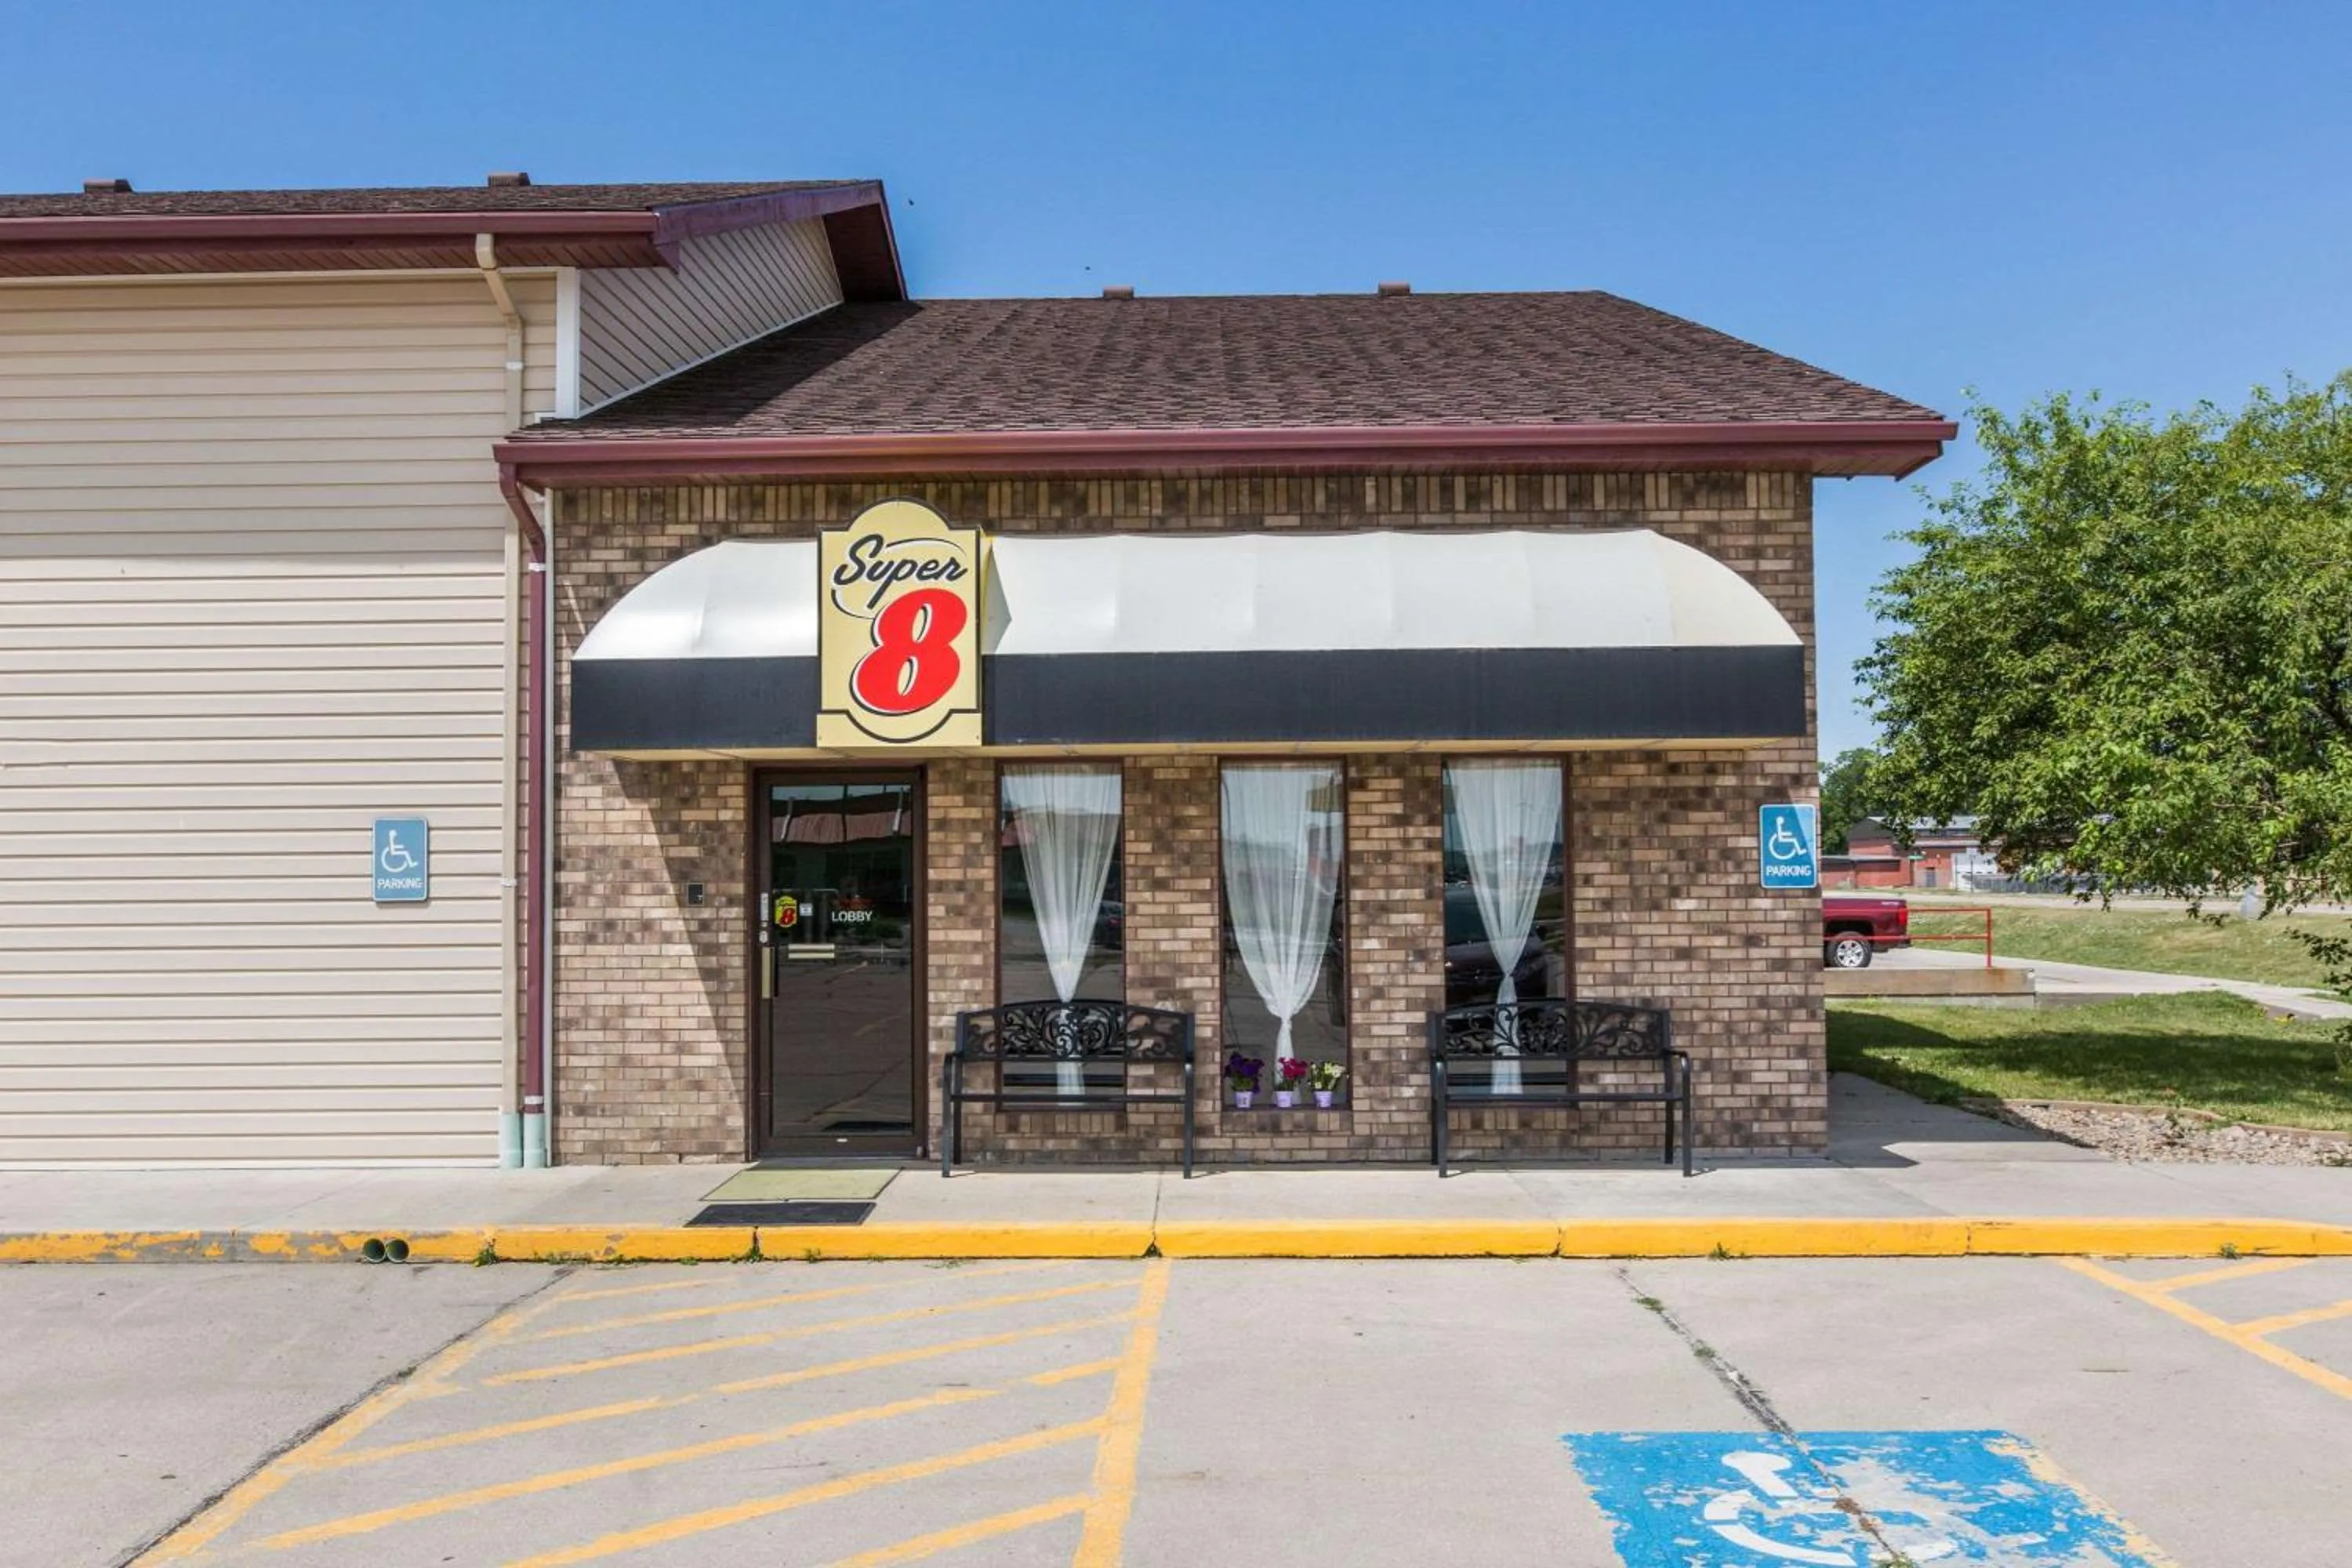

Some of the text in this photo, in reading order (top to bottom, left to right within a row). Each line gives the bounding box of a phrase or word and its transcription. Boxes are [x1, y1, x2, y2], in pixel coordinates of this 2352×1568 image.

[833, 534, 968, 610] Super
[850, 587, 968, 716] 8
[1766, 866, 1812, 877] PARKING
[377, 878, 423, 889] PARKING
[832, 910, 873, 923] LOBBY
